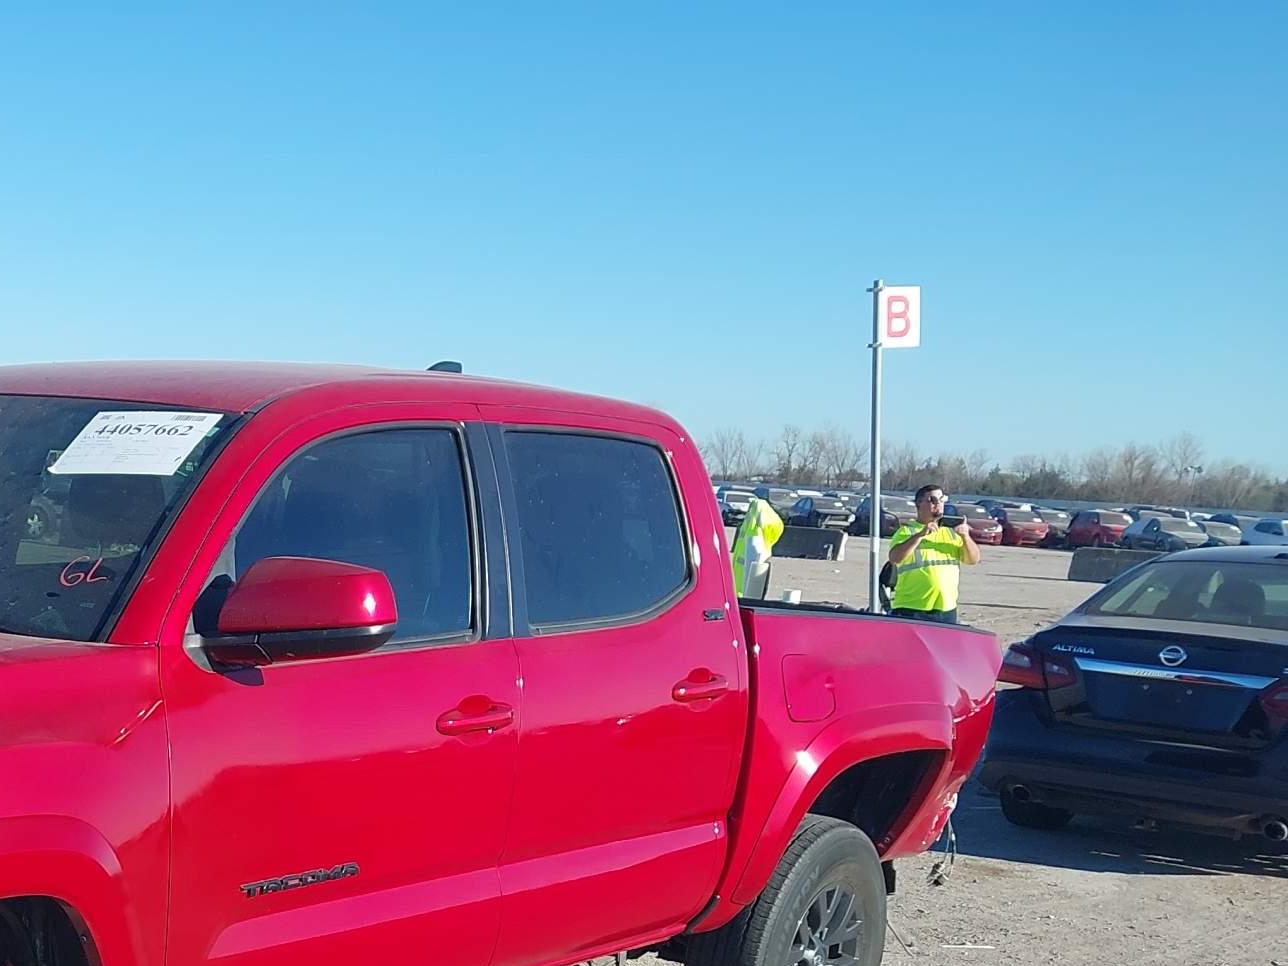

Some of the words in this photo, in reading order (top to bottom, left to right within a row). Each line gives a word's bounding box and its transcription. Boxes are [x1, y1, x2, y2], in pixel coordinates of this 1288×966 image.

[887, 295, 911, 338] B
[95, 423, 194, 436] 44057662
[1052, 643, 1096, 656] ALTIMA
[240, 862, 361, 899] TACOMA
